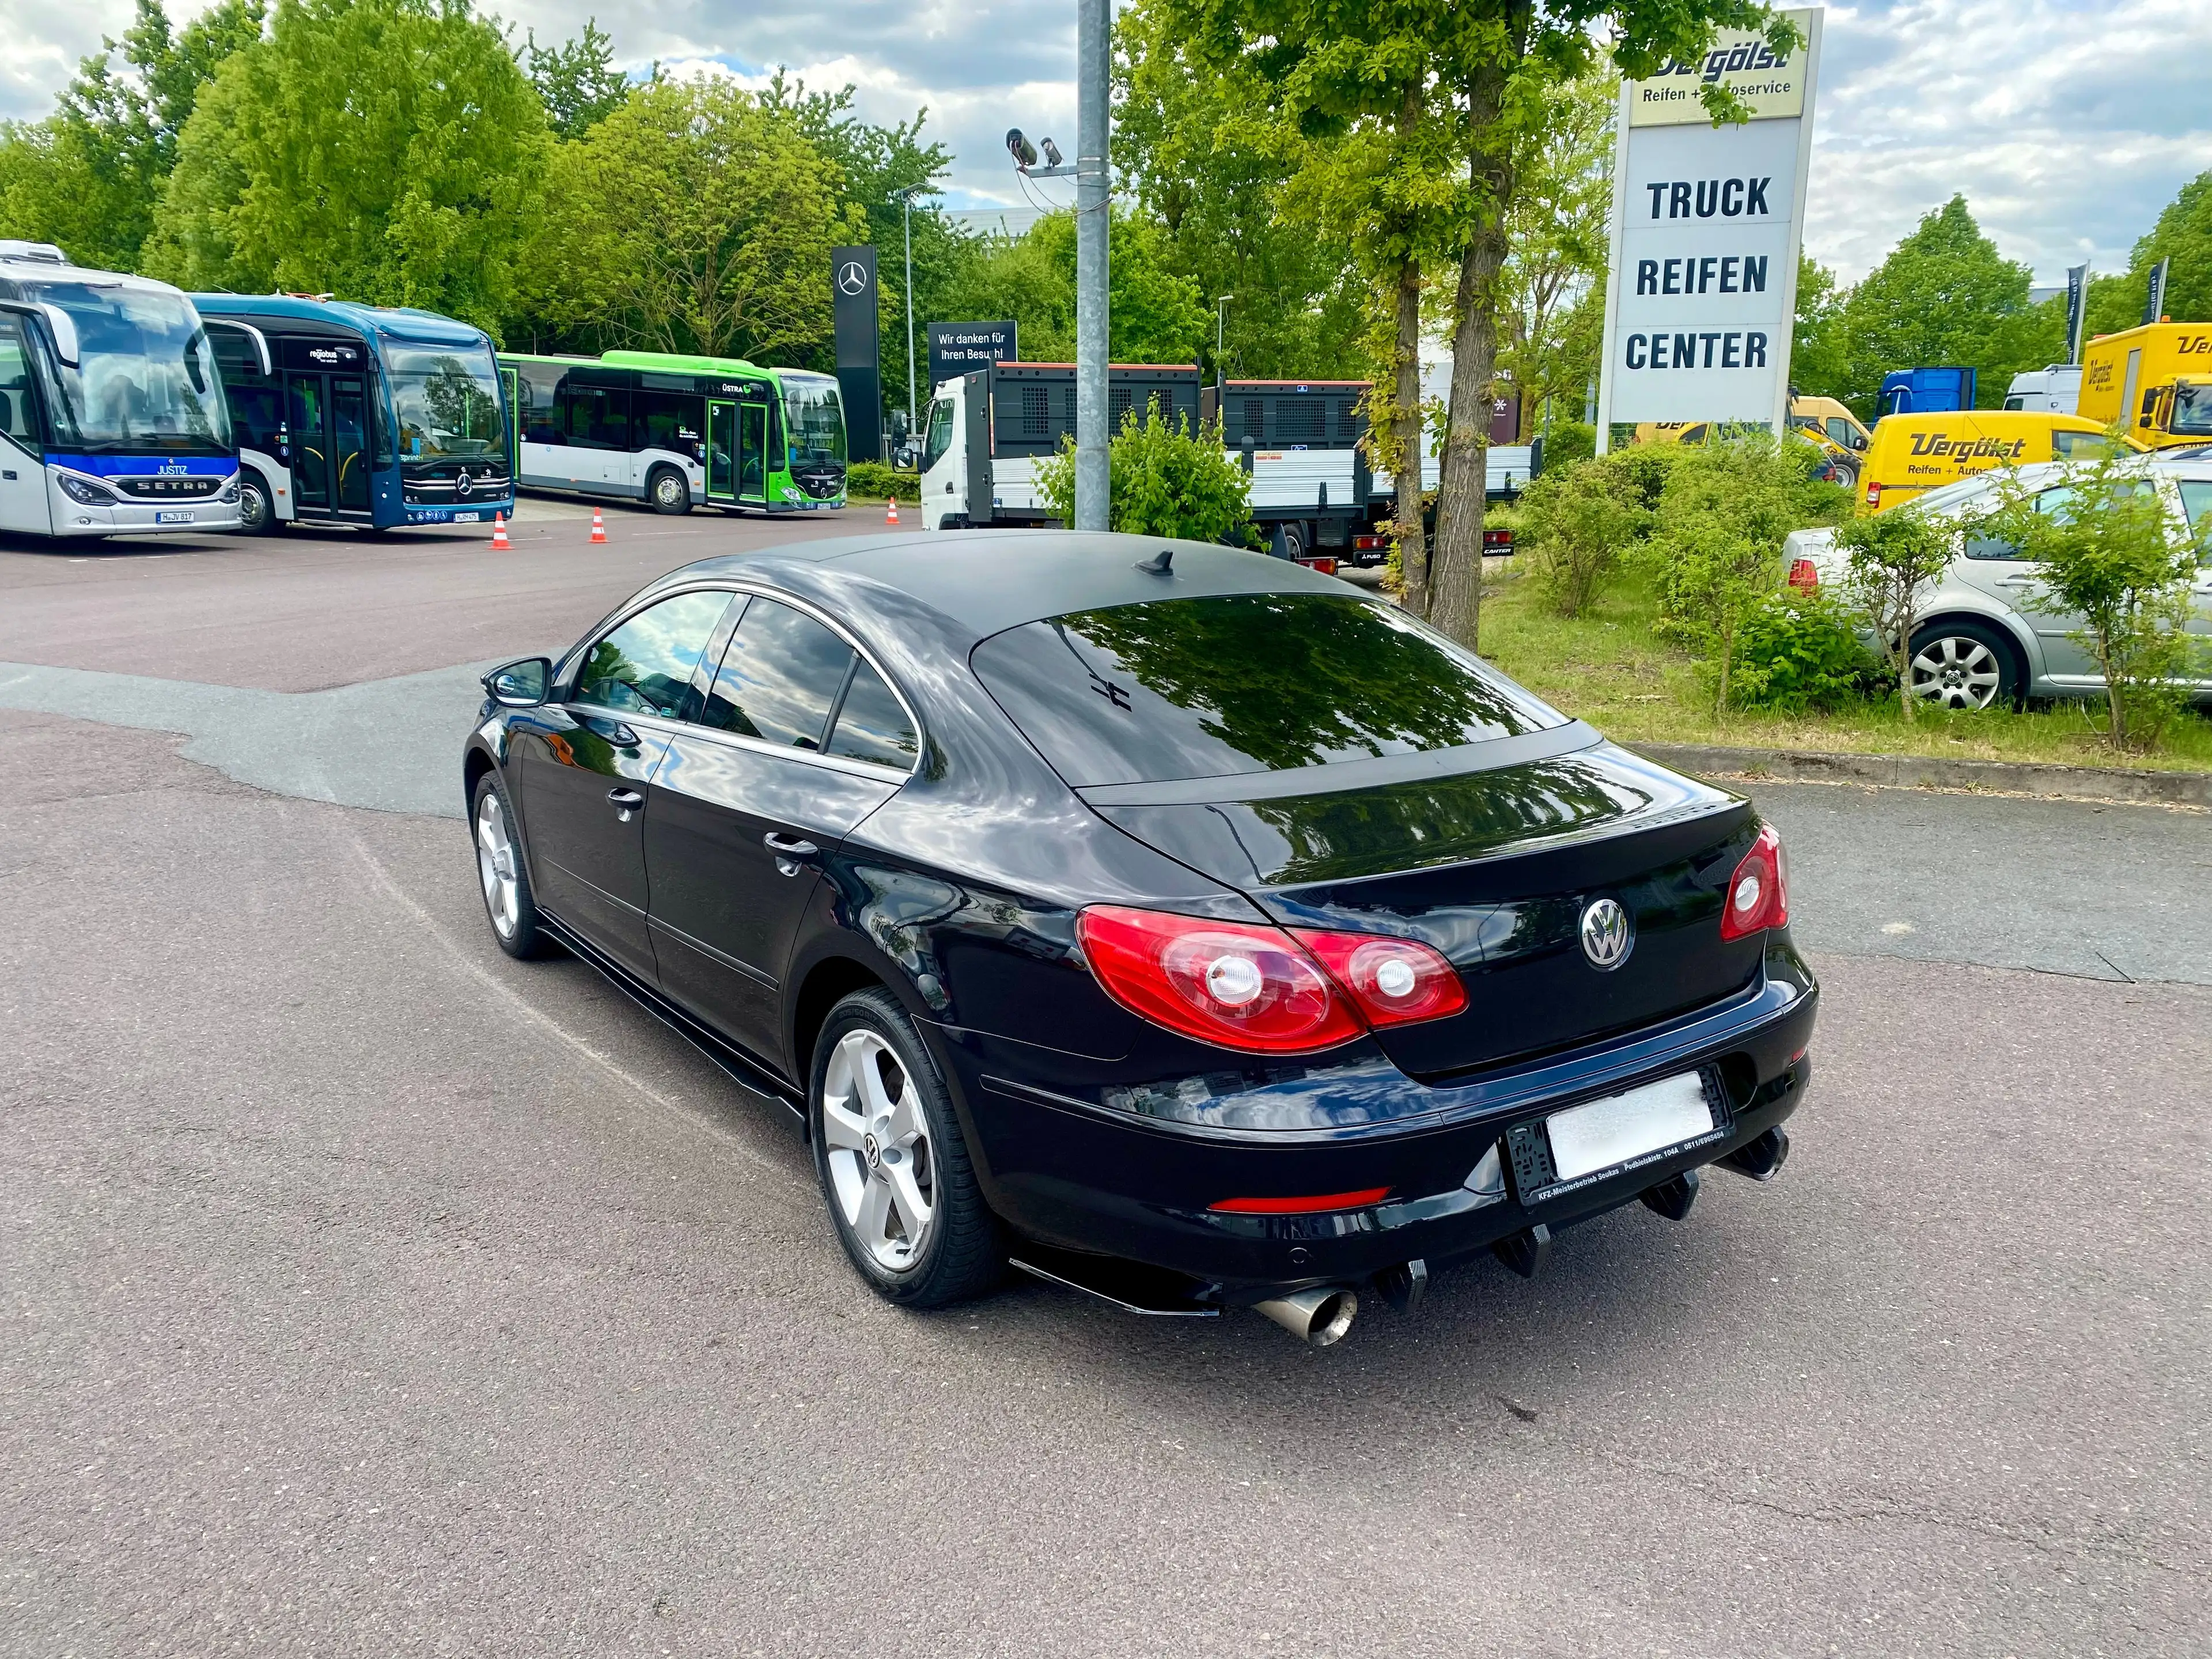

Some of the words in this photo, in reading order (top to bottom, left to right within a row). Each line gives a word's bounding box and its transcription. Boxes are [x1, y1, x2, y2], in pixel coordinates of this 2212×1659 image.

[1643, 88, 1685, 102] Reifen
[1691, 89, 1700, 99] +
[1708, 81, 1790, 97] oservice
[1647, 177, 1772, 219] TRUCK
[1637, 255, 1768, 296] REIFEN
[938, 334, 955, 344] Wir
[956, 333, 990, 344] danken
[991, 332, 1005, 343] für
[941, 349, 964, 359] Ihren
[967, 348, 1003, 359] Besuh!
[1626, 332, 1767, 370] CENTER
[157, 465, 188, 475] JUSTIZ
[1908, 465, 1941, 475] Reifen
[137, 482, 207, 490] SETRA
[1538, 1175, 1597, 1200] KFZ-Meisterbetrieb
[1598, 1168, 1619, 1180] Soukas
[1624, 1154, 1663, 1171] Podbielskistr.
[1664, 1147, 1680, 1158] 104A
